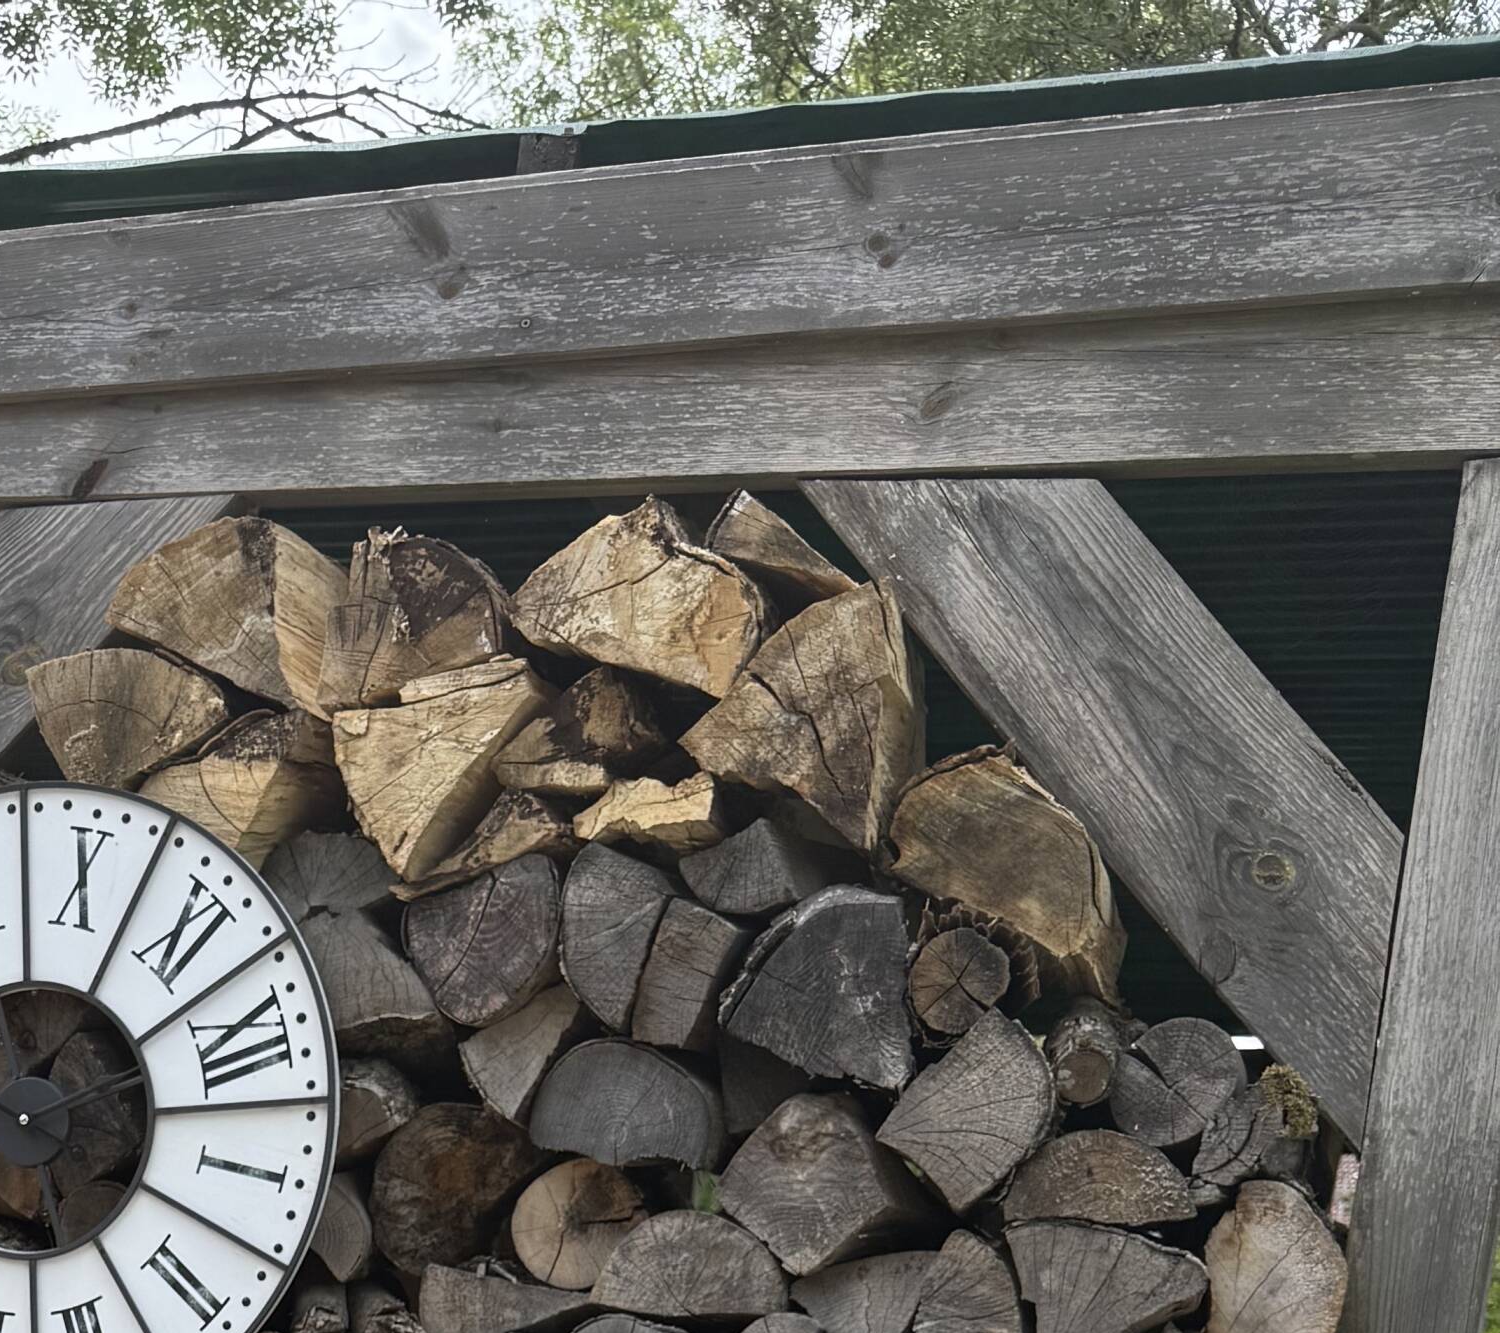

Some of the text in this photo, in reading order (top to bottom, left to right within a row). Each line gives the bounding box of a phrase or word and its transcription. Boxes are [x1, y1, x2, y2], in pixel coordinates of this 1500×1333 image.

[48, 826, 114, 932] X
[132, 874, 236, 994] XI
[187, 984, 292, 1099] XII
[197, 1146, 287, 1193] I
[141, 1234, 230, 1331] II
